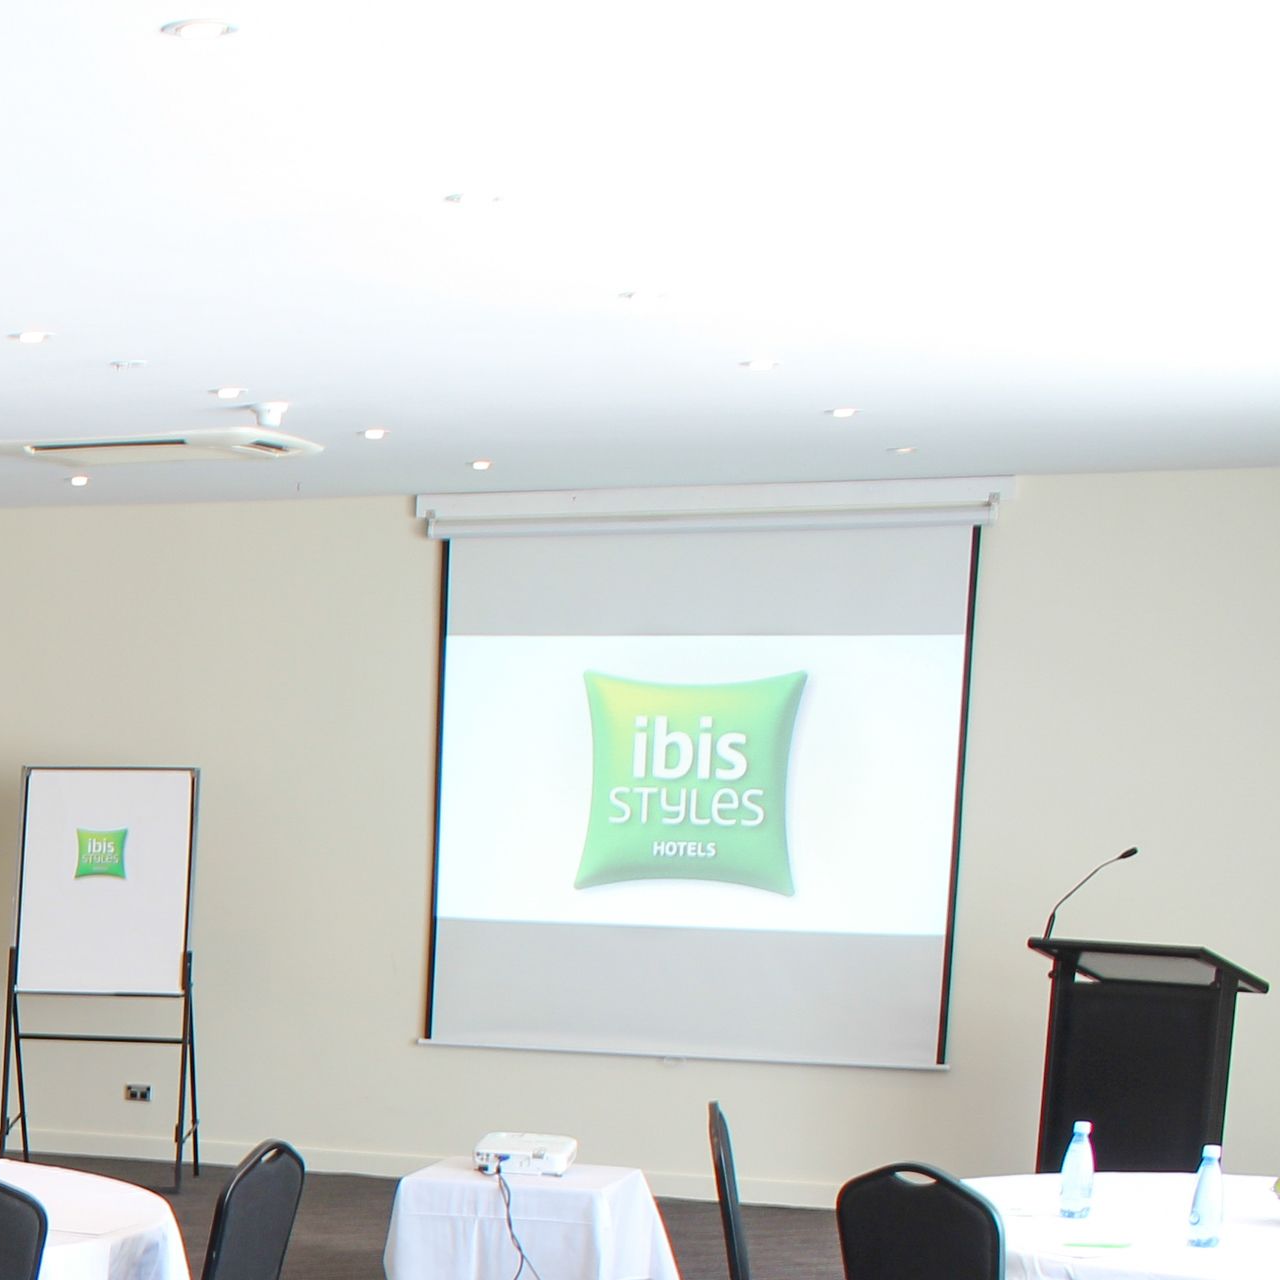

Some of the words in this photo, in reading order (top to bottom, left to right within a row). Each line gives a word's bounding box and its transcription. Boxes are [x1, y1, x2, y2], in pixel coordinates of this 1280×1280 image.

[632, 715, 748, 780] ibis
[87, 838, 115, 854] ibis
[652, 841, 717, 857] HOTELS
